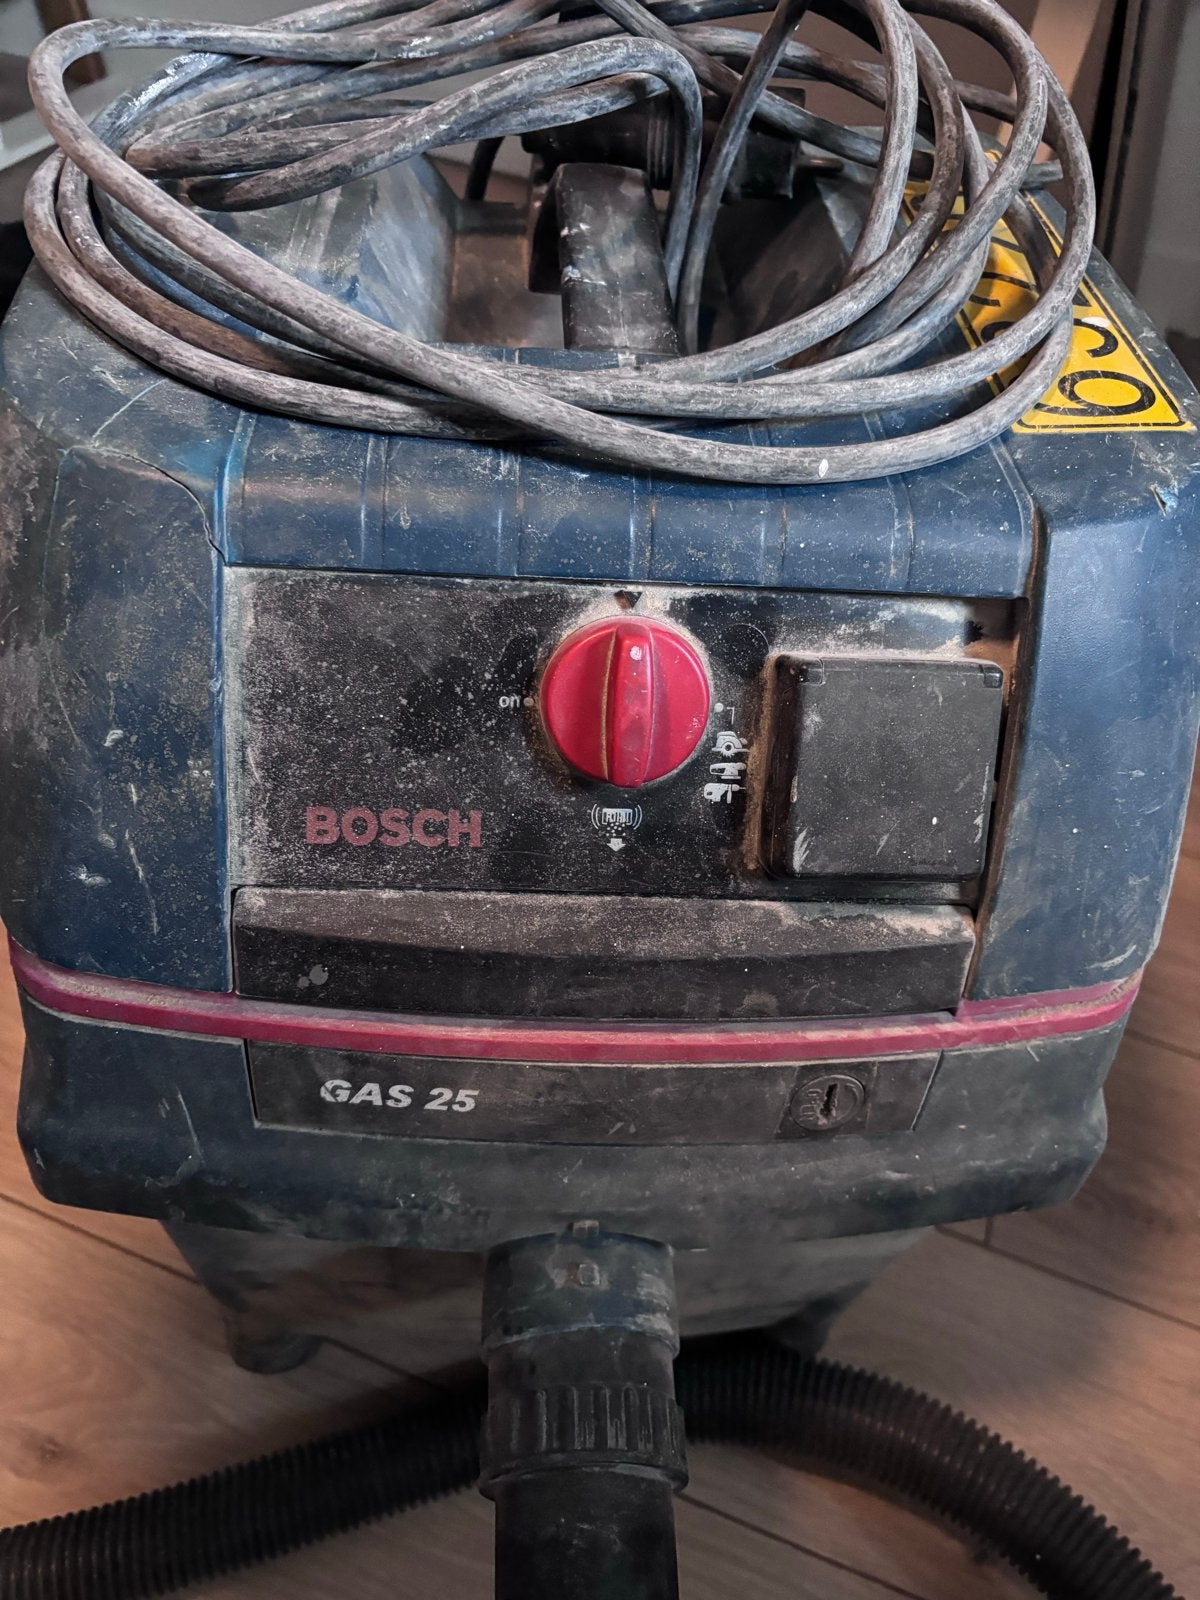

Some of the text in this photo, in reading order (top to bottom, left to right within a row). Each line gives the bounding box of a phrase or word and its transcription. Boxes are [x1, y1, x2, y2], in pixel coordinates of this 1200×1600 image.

[499, 694, 520, 708] on
[306, 806, 482, 847] BOSCH
[320, 1079, 480, 1112] GAS 25
